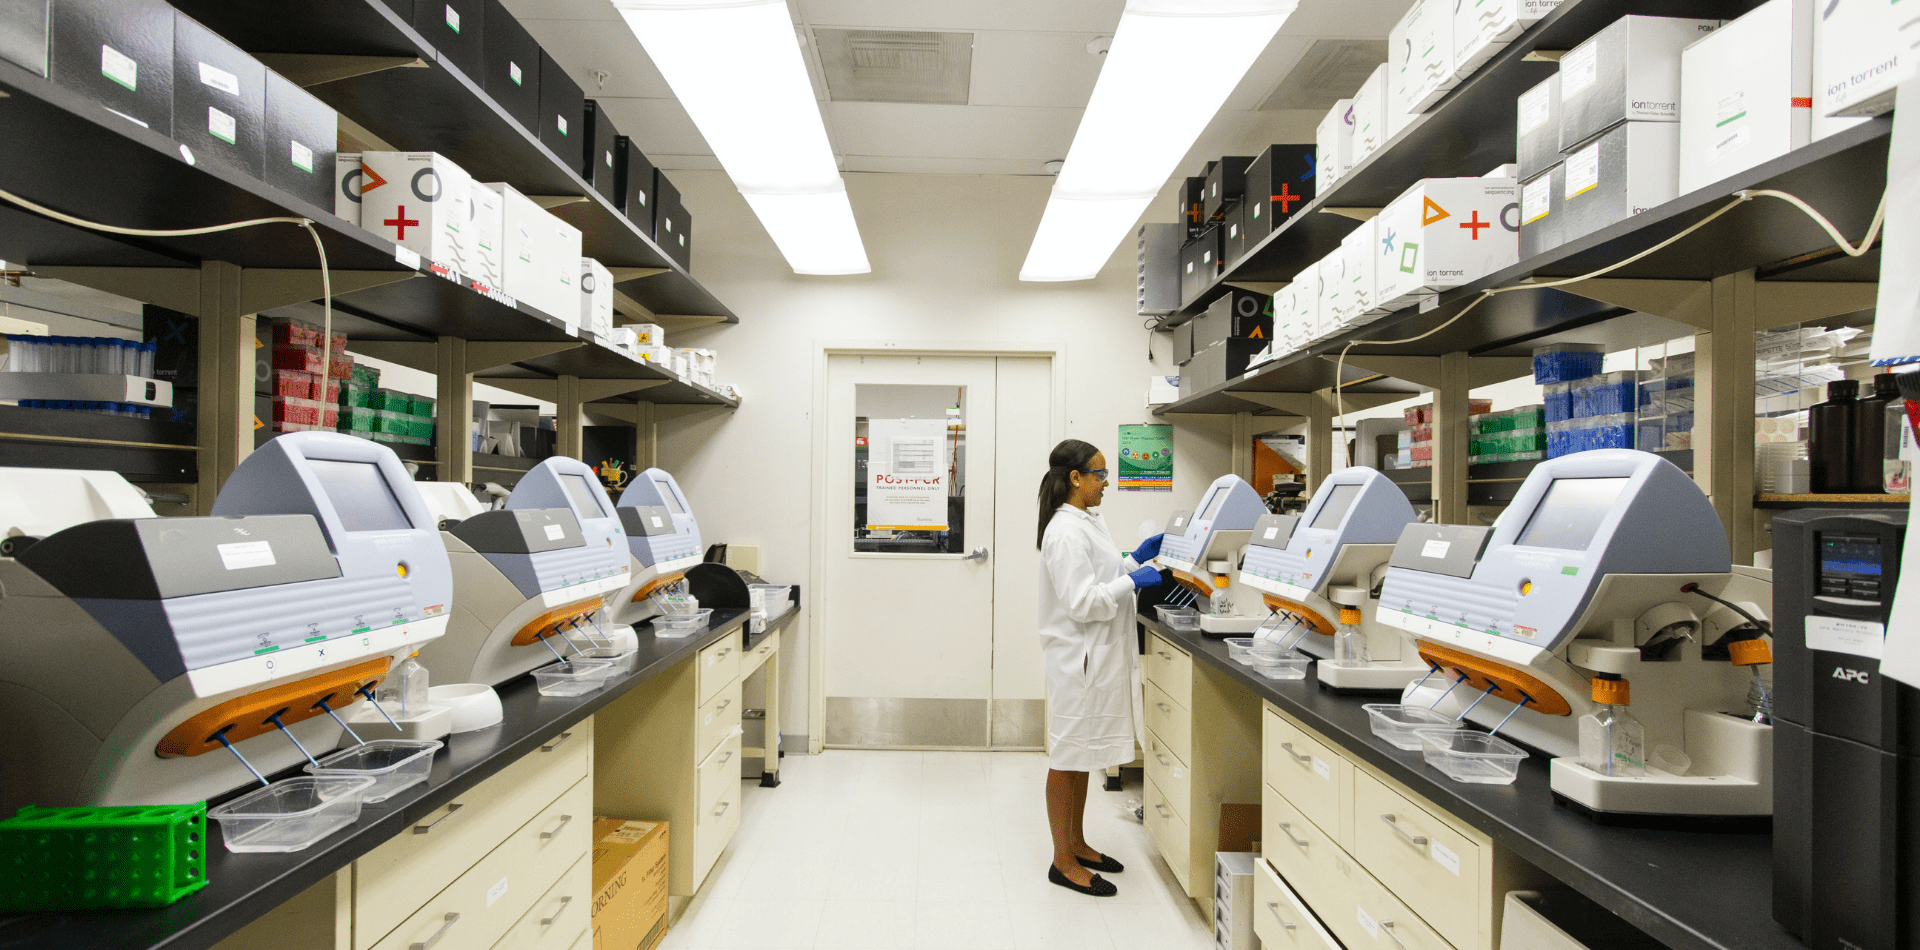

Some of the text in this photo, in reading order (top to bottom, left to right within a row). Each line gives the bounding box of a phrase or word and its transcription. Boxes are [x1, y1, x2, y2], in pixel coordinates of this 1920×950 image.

[1827, 55, 1898, 97] ion torrent
[1427, 269, 1438, 277] ion
[1832, 666, 1870, 685] APC
[592, 870, 626, 918] ORNING
